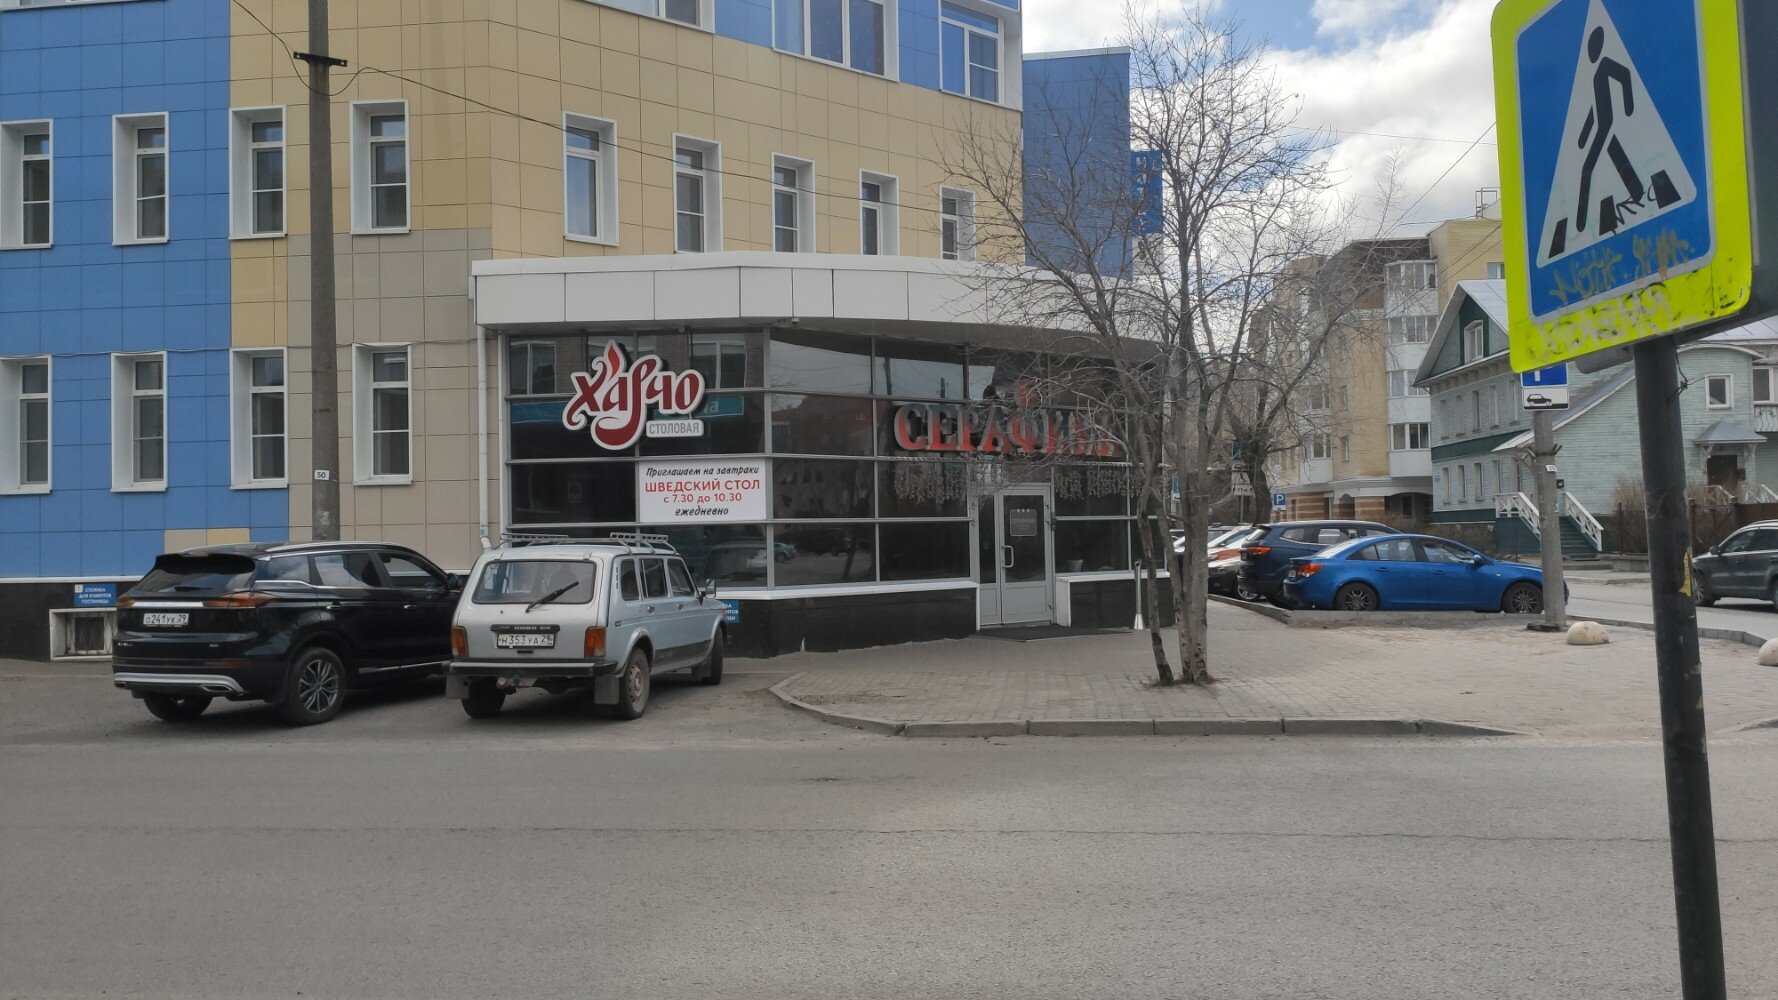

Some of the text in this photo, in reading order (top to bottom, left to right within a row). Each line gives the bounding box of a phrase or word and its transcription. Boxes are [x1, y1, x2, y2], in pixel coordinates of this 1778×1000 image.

[650, 422, 700, 435] СТОЛОВАЯ
[646, 466, 760, 477] Приглашаем на завтраки
[645, 478, 760, 493] ШВЕДСКИЙ СТОЛ
[672, 494, 694, 503] 7.30
[696, 495, 711, 504] до
[714, 492, 742, 502] 10.30
[675, 505, 729, 516] ежедневно
